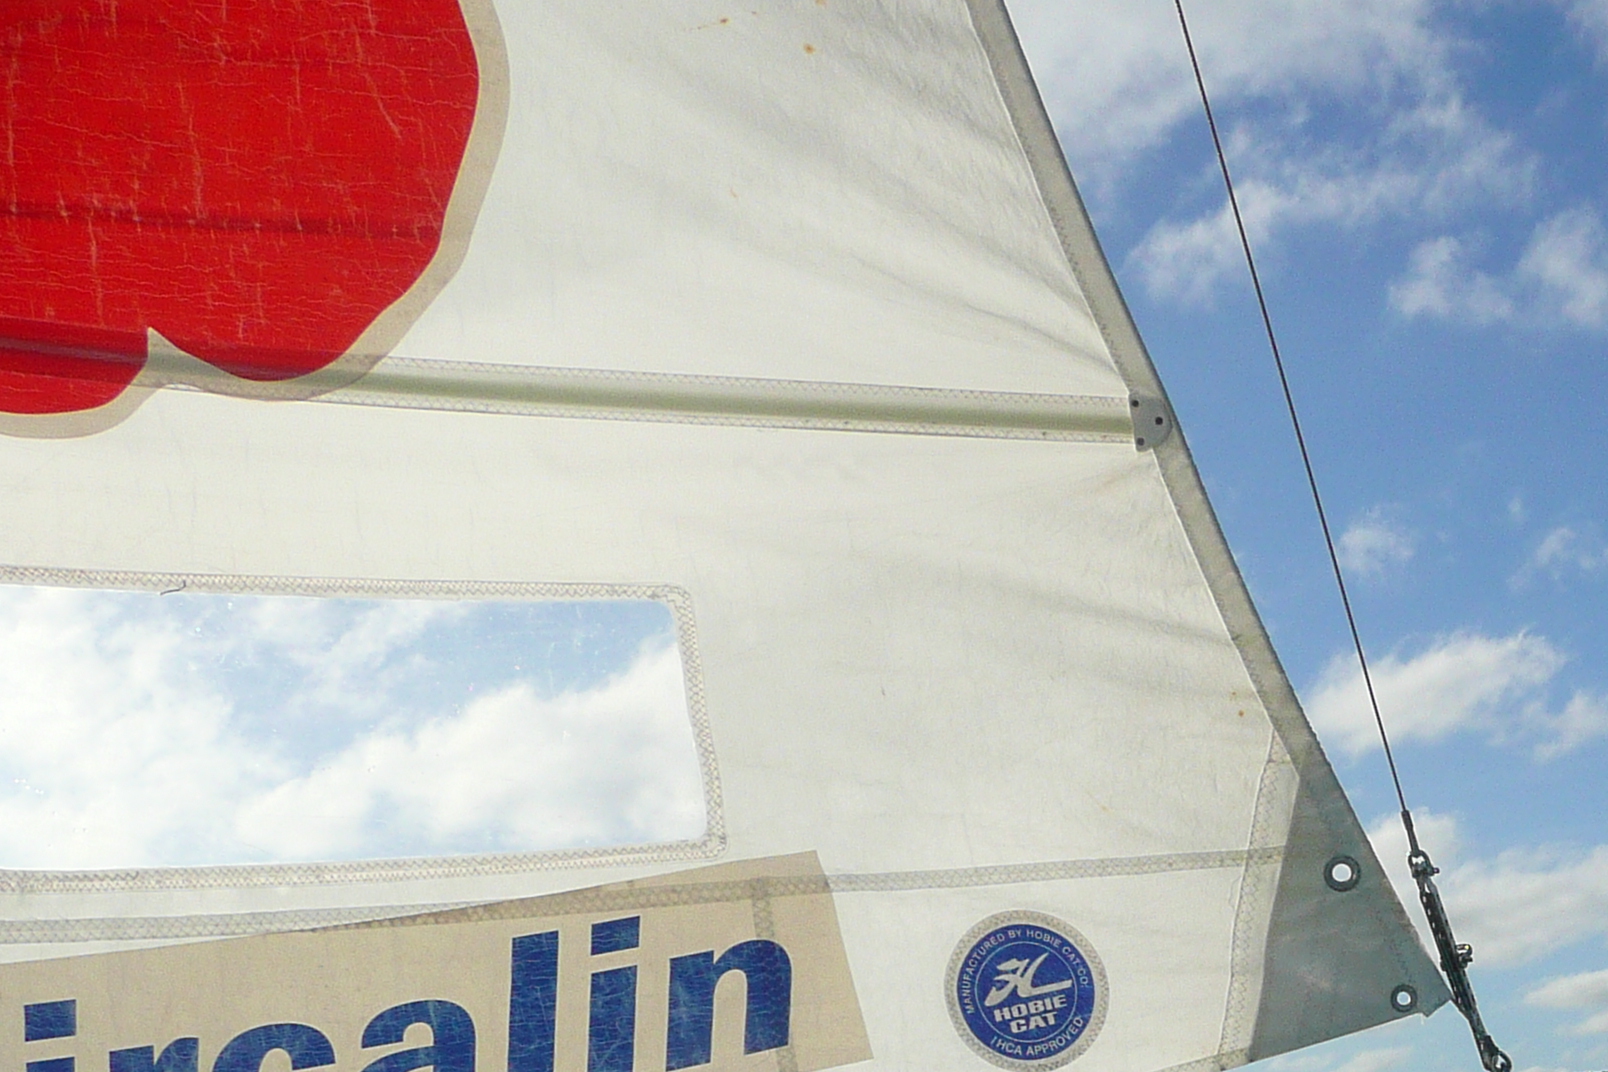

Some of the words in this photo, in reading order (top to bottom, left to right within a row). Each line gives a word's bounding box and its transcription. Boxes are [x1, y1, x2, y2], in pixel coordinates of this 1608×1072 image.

[962, 933, 1005, 1014] MANUFACTURED
[1008, 929, 1022, 939] BY
[1026, 929, 1062, 948] HOBIE
[1062, 946, 1081, 966] CAT
[993, 994, 1068, 1022] HOBIE
[1009, 1011, 1058, 1034] CAT
[1026, 1016, 1084, 1056] APPROVED
